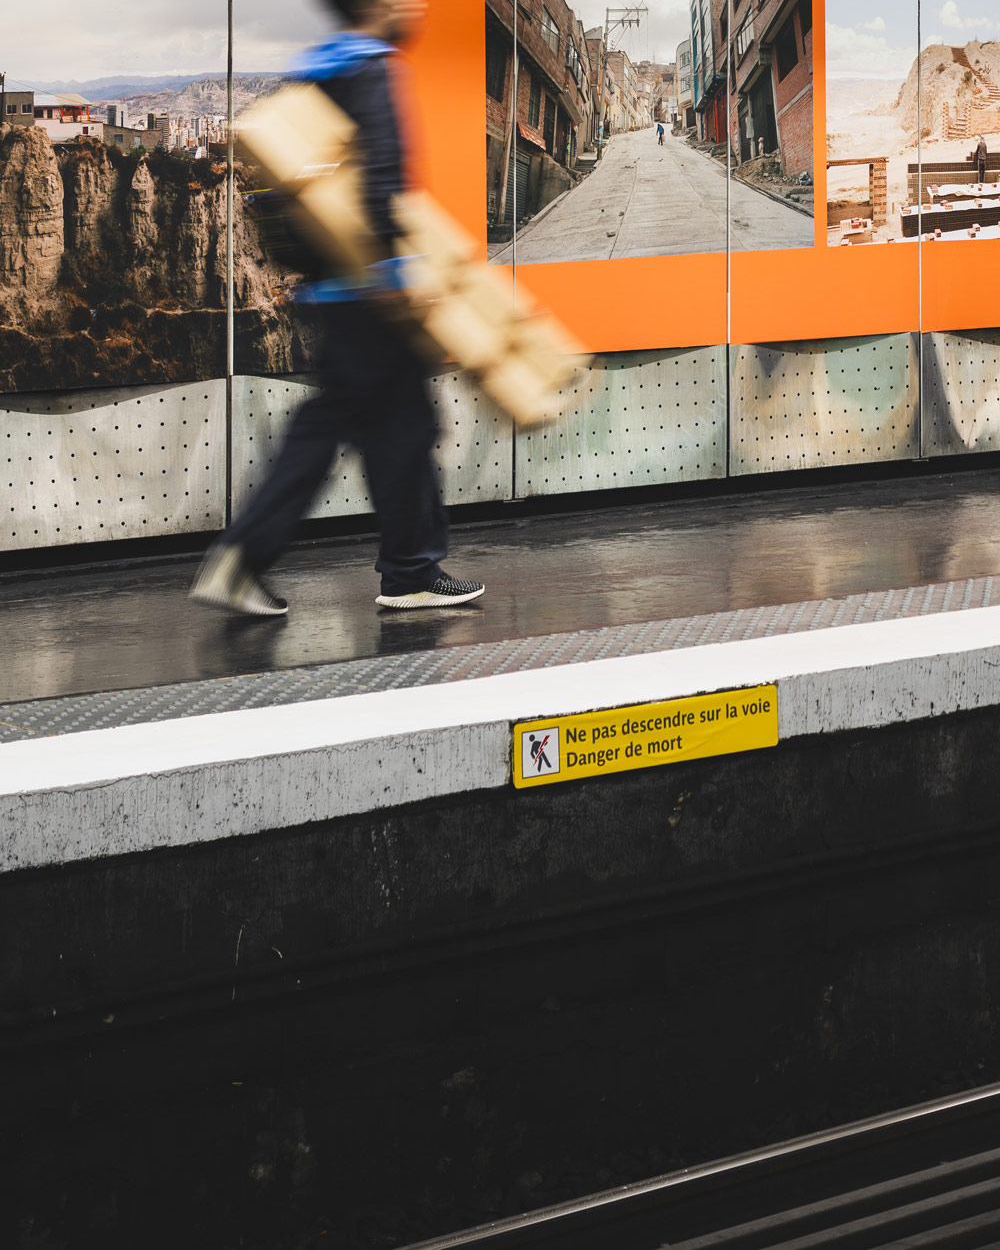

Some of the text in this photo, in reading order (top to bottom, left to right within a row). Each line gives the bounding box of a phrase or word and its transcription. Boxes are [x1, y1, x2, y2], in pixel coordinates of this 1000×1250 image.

[566, 698, 771, 744] Ne pas descendre sur la voie
[566, 735, 683, 768] Danger de mort
